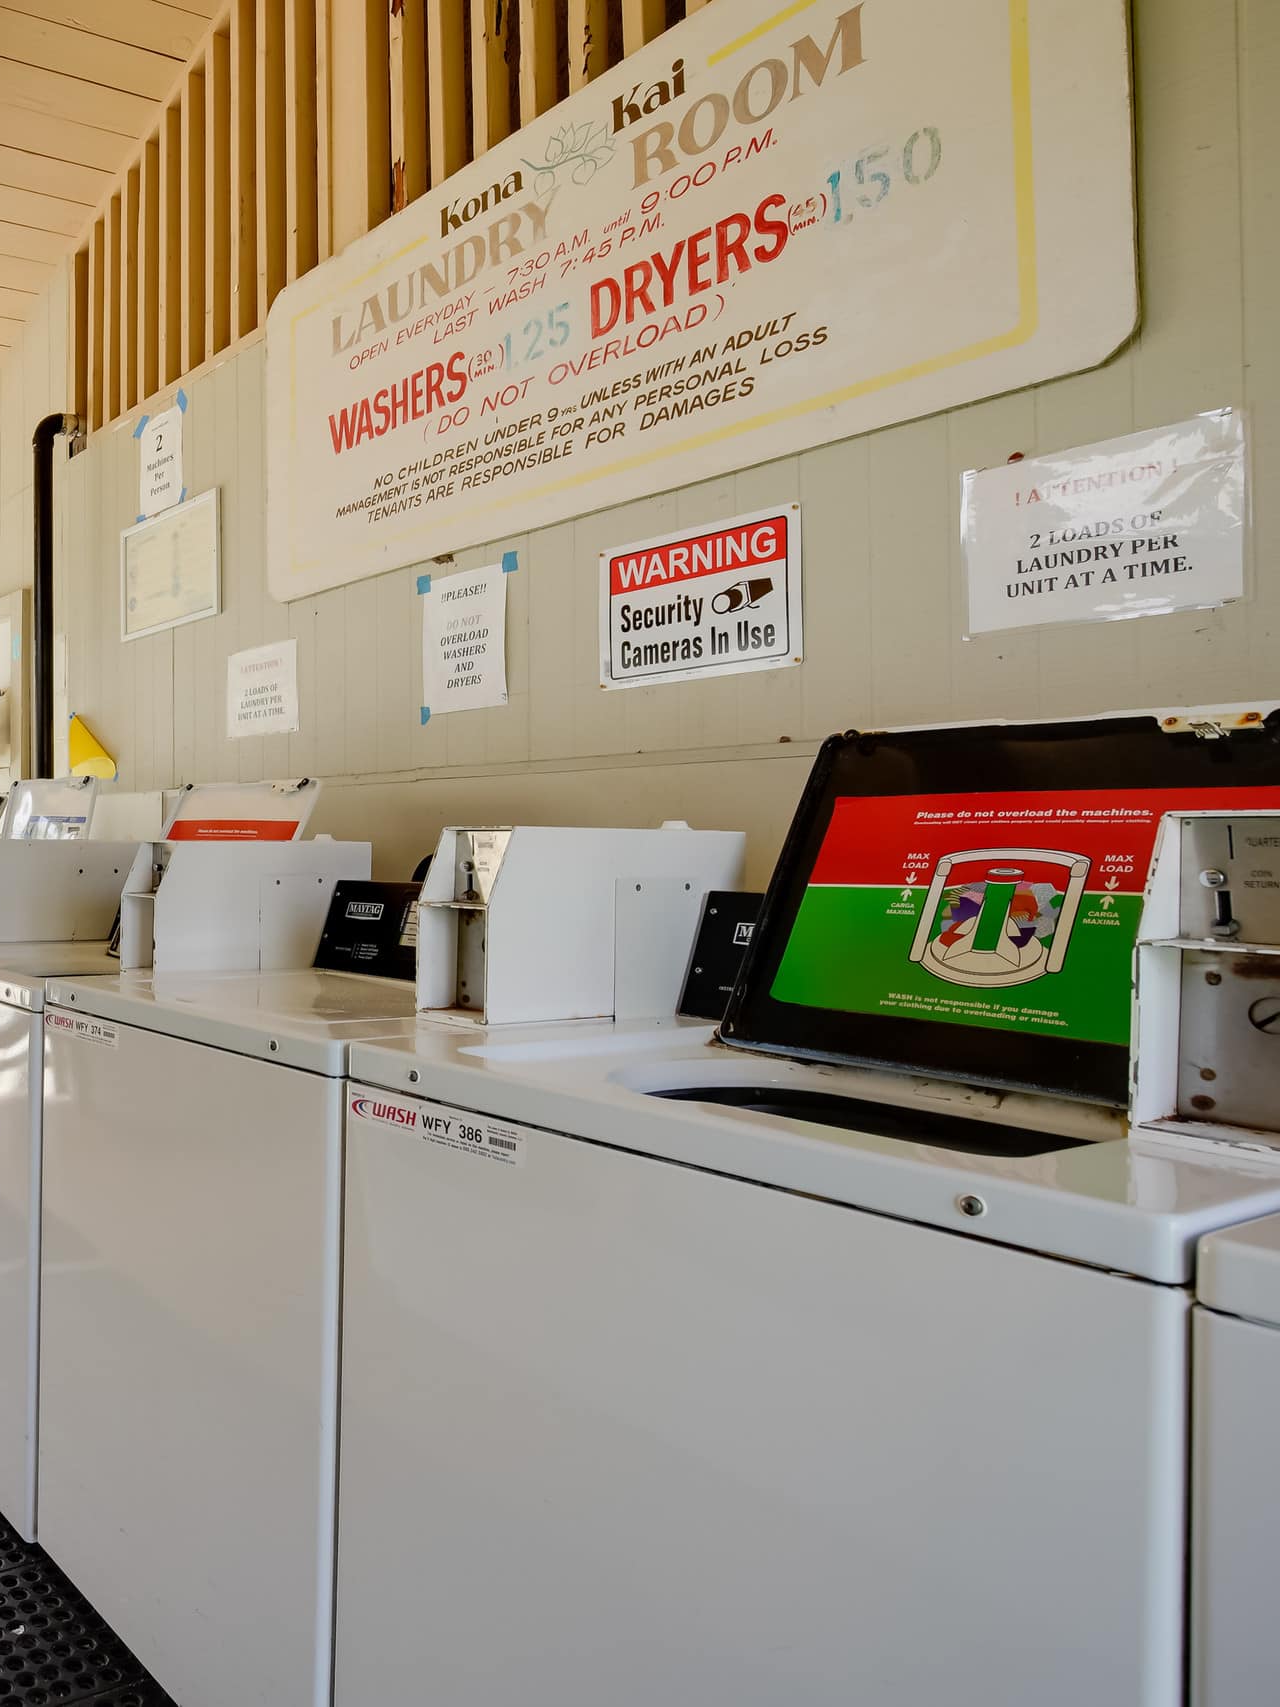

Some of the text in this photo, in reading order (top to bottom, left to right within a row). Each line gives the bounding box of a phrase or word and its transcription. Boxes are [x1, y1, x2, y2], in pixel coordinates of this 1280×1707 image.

[439, 58, 686, 239] Kona Kai
[331, 2, 867, 357] LAUNDRY ROOM
[349, 338, 389, 371] OPEN
[396, 289, 476, 345] EVERYDAY
[507, 253, 550, 283] 7:30
[554, 228, 591, 262] A.M.
[603, 209, 631, 235] until
[641, 161, 716, 214] 9:00
[721, 128, 778, 173] P.M.
[590, 193, 789, 340] DRYERS
[433, 309, 479, 345] LAST
[489, 272, 546, 317] WASH
[619, 212, 665, 249] P.M.
[328, 351, 466, 455] WASHERS
[374, 472, 394, 490] NO
[398, 438, 479, 480] CHILDREN
[484, 413, 542, 447] UNDER
[580, 373, 642, 409] UNLESS
[645, 355, 686, 385] WITH
[689, 343, 718, 368] AN
[721, 312, 798, 356] ADULT
[480, 376, 535, 417] NOT
[336, 326, 829, 519] MANAGEMENT IS NOT RESPONSIBLE FOR ANY PERSONAL LOSS
[156, 434, 163, 452] 2
[368, 376, 756, 524] TENANTS ARE RESPONSIBLE FOR DAMAGES
[1029, 510, 1163, 549] 2 LOADS OF
[618, 526, 777, 589] WARNING
[1016, 534, 1179, 574] LAUNDRY PER
[1006, 556, 1193, 599] UNIT AT A TIME.
[461, 614, 483, 628] NOT
[620, 594, 704, 634] Security
[440, 628, 489, 647] OVERLOAD
[442, 643, 487, 660] WASHERS
[621, 620, 776, 669] Cameras In Use
[446, 674, 483, 689] DRYERS
[454, 661, 474, 674] AND
[916, 808, 1154, 819] Please do not overload the machines.
[1099, 865, 1134, 873] LOAD
[1104, 854, 1135, 863] MAX
[349, 903, 380, 915] MAYTAG
[1082, 918, 1121, 926] MAXIMA
[54, 1015, 74, 1029] WASH
[888, 993, 913, 1001] WASH
[940, 999, 991, 1010] responsible
[1021, 1008, 1059, 1017] damage
[899, 1001, 932, 1011] clothing
[963, 1009, 1017, 1021] overloading
[372, 1102, 417, 1127] WASH
[422, 1114, 451, 1134] WFY
[458, 1124, 483, 1143] 386
